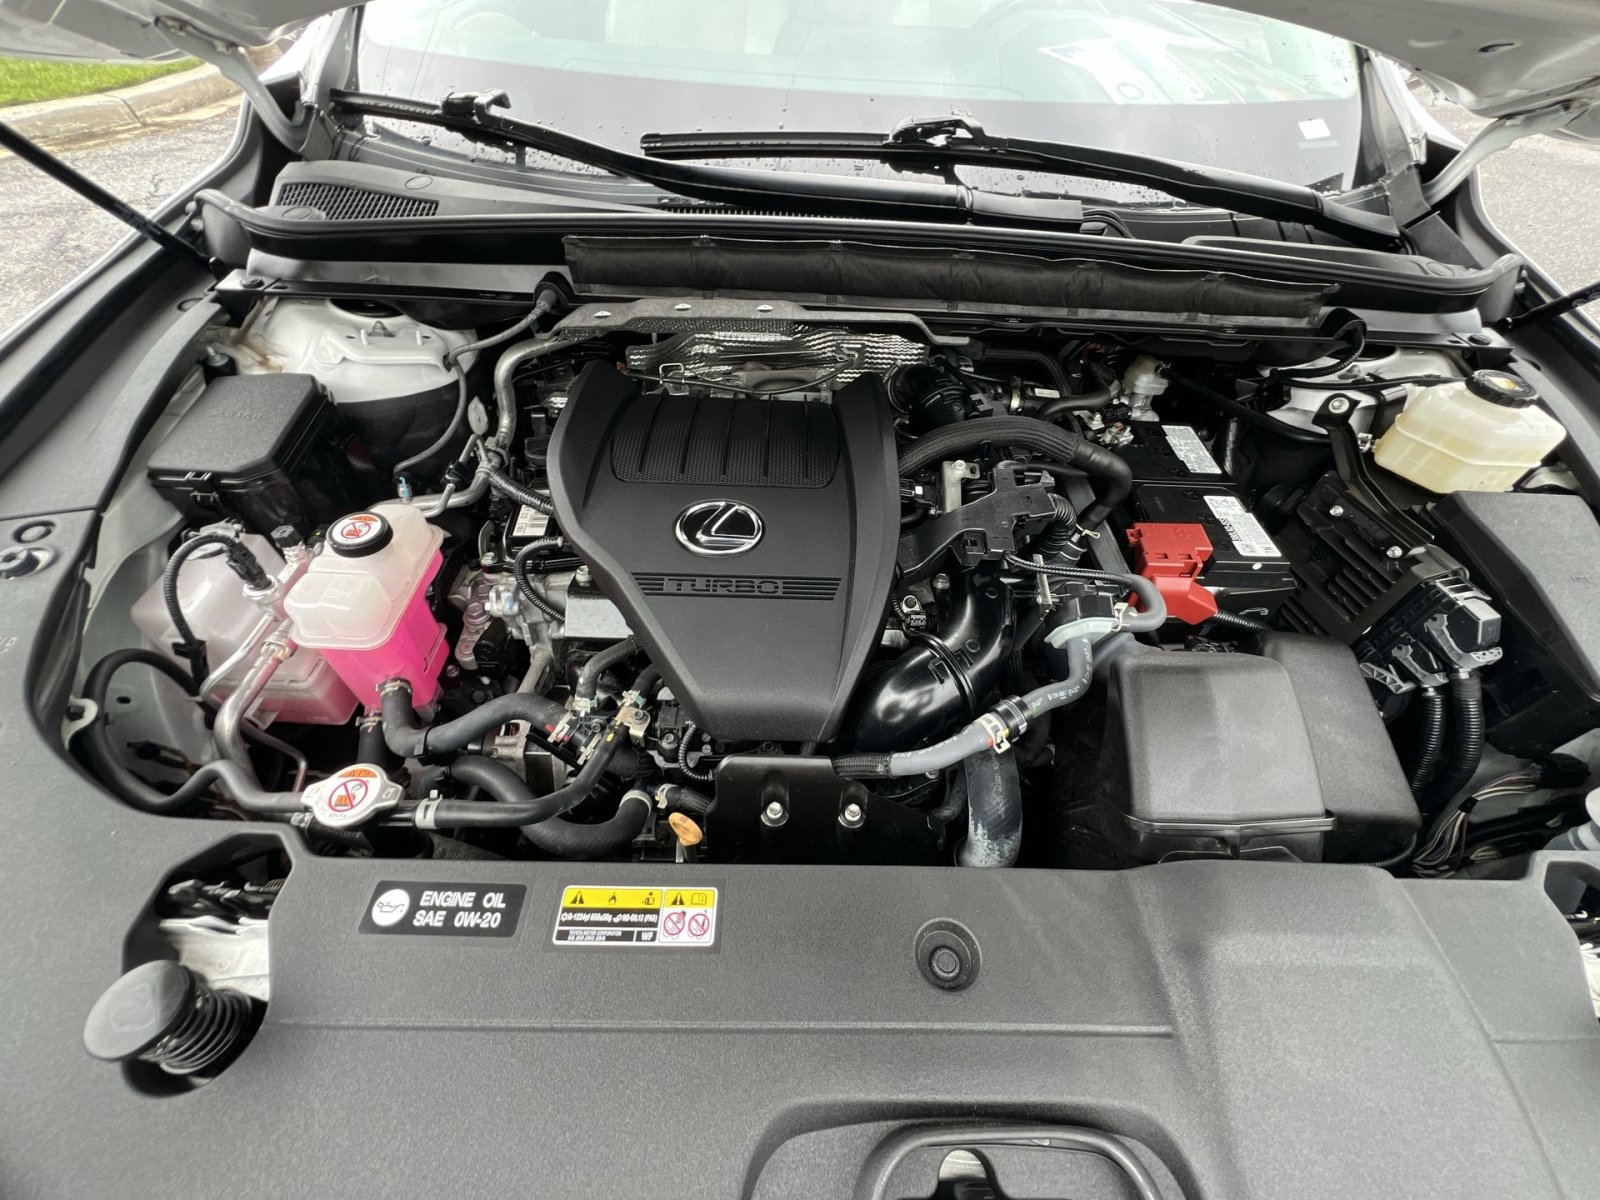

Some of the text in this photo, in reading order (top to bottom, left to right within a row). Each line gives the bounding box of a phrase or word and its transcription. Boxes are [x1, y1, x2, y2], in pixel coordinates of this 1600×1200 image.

[667, 578, 780, 595] TURBO
[420, 891, 506, 908] ENGINE OIL
[413, 910, 501, 928] SAE 0W-20
